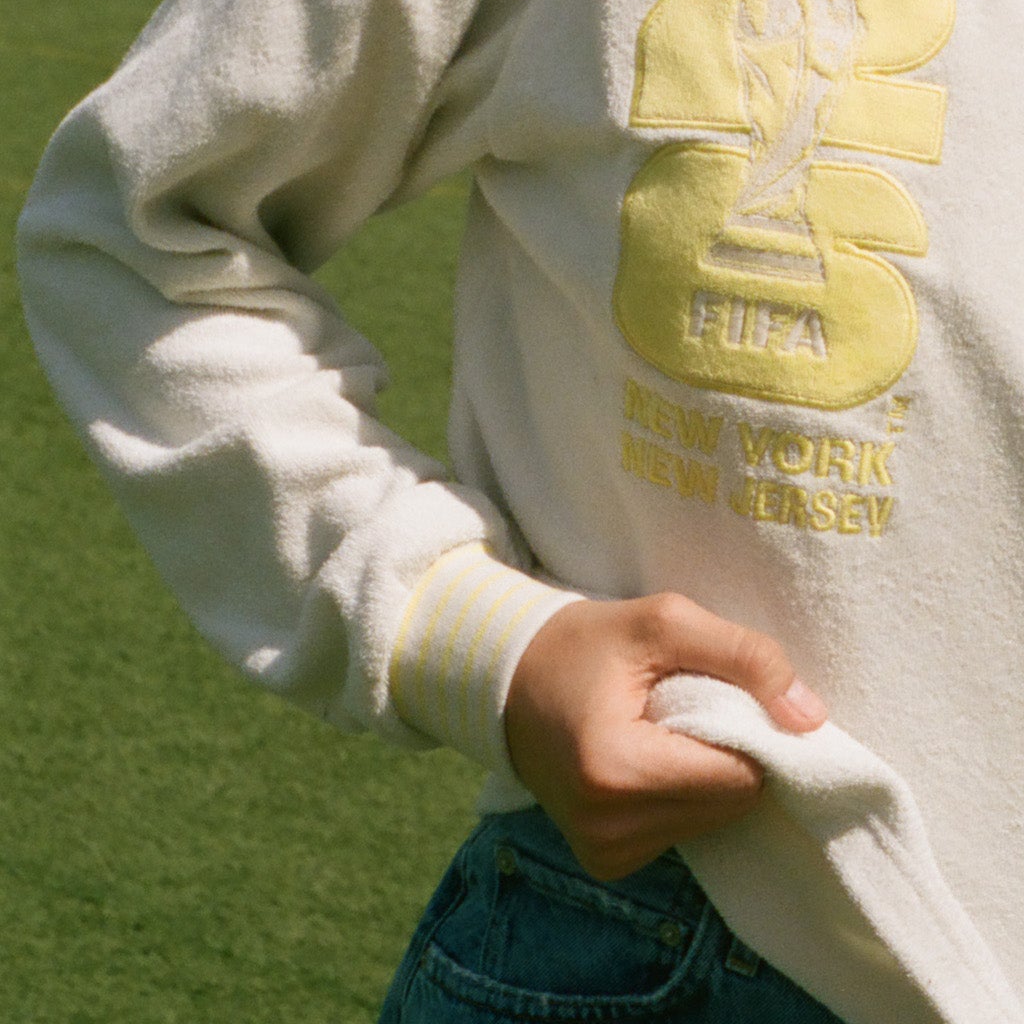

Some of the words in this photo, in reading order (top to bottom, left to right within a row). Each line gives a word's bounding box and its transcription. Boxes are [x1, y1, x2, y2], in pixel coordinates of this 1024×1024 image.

[690, 291, 828, 357] FIFA
[620, 430, 720, 504] NEW
[728, 475, 895, 538] JERSEY
[622, 378, 724, 457] NEW
[736, 421, 896, 486] YORK
